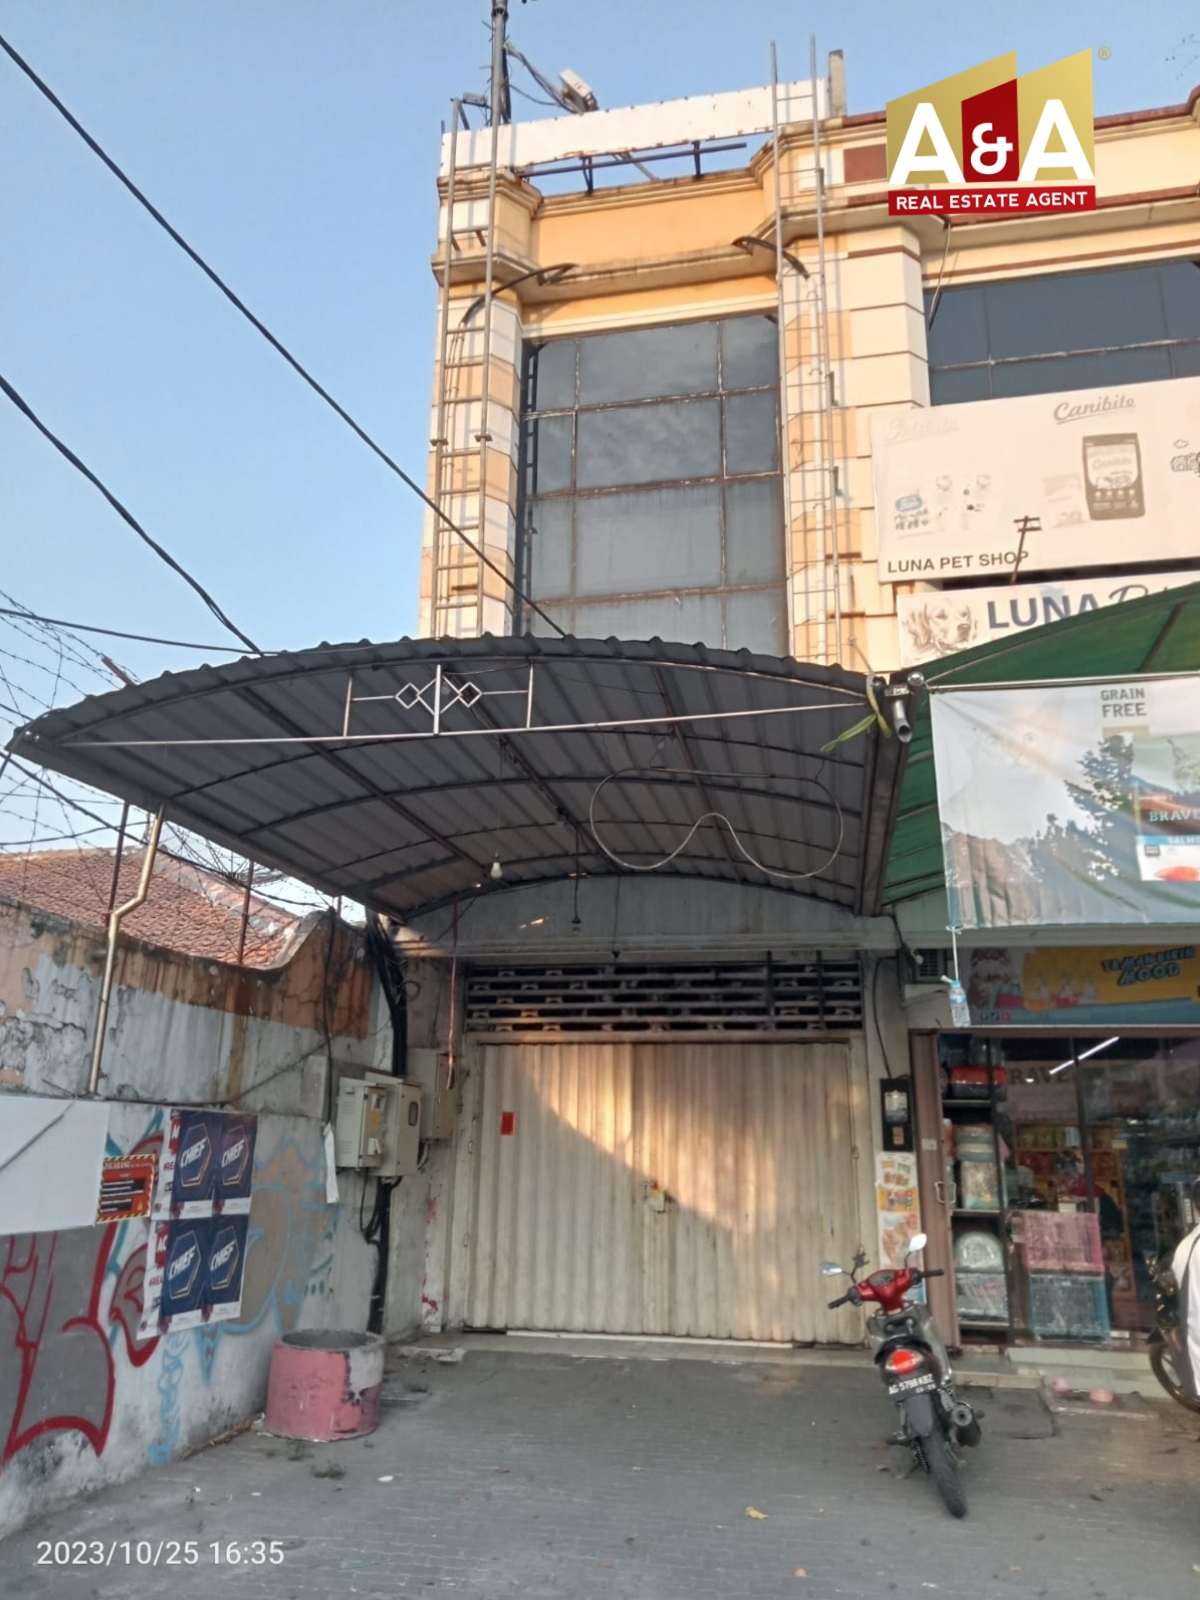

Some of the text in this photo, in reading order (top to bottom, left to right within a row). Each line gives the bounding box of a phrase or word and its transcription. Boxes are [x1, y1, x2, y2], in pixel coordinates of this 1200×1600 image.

[1053, 394, 1137, 421] Canibite
[888, 550, 1030, 574] LUNA PET SHOP
[1100, 687, 1146, 701] GRAIN
[1101, 702, 1148, 718] FREE
[1117, 961, 1180, 986] MOOD
[181, 1136, 207, 1168] CHIEF
[221, 1138, 245, 1168] CHIEF
[168, 1244, 197, 1281] CHIEF
[209, 1239, 235, 1272] CHIEF
